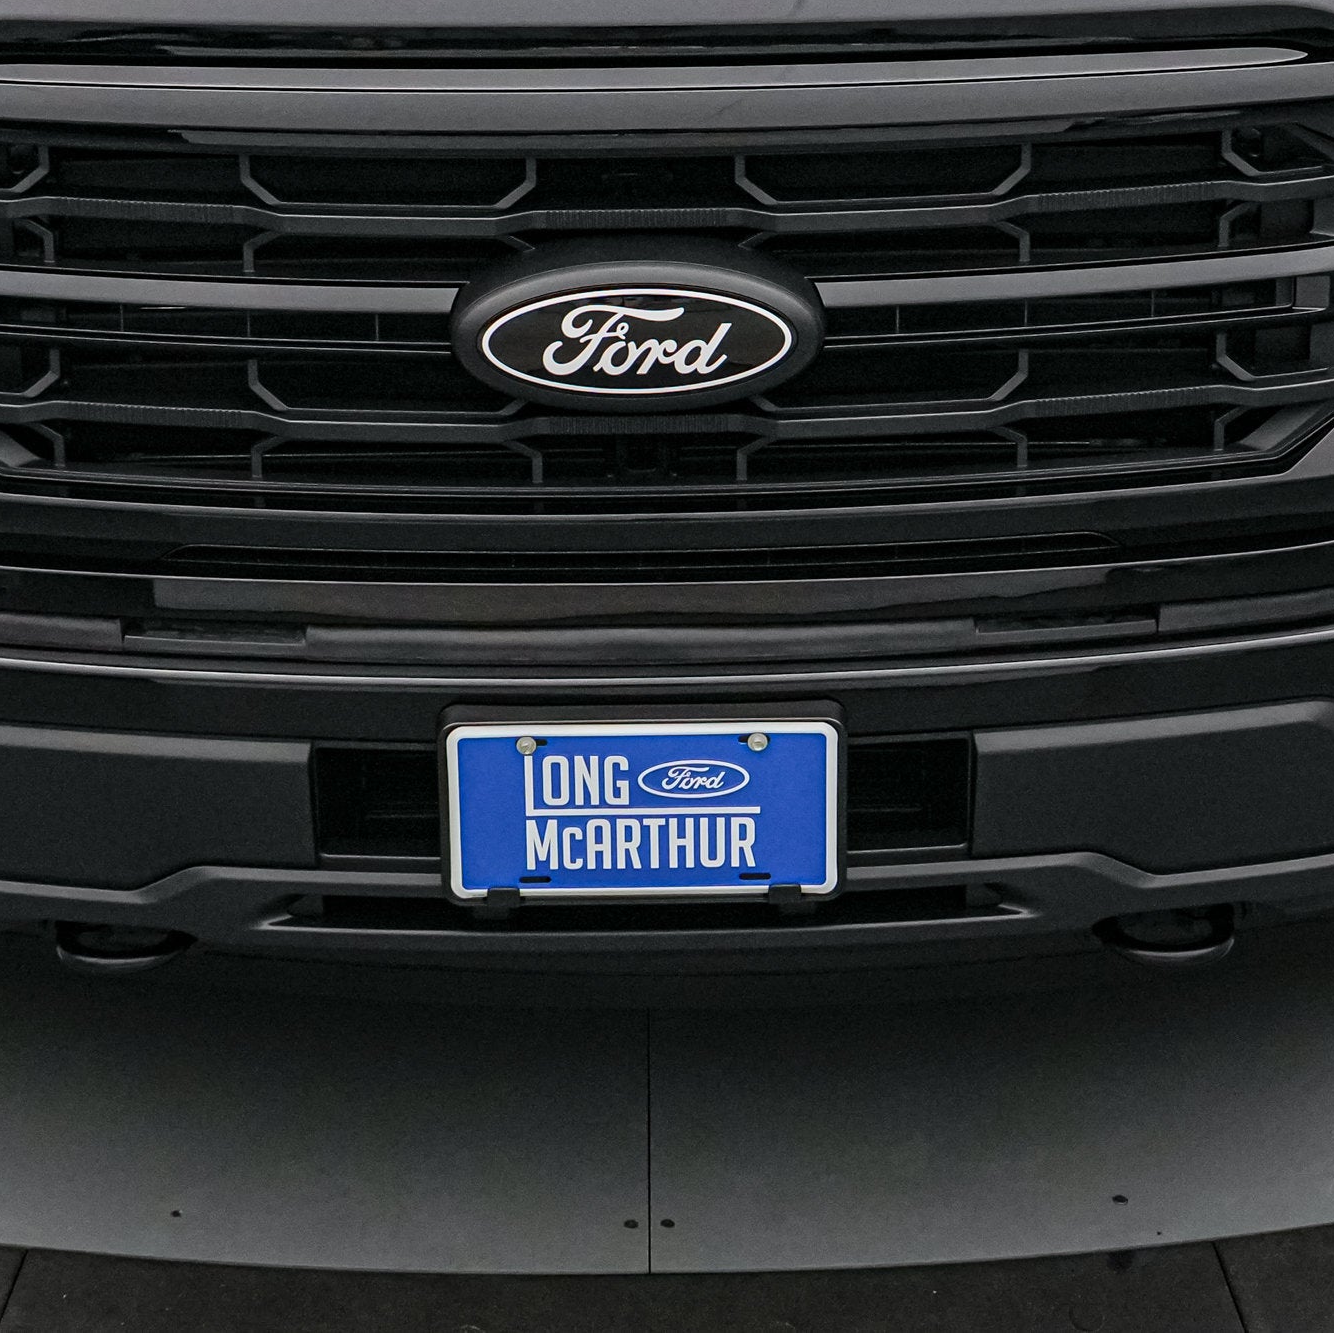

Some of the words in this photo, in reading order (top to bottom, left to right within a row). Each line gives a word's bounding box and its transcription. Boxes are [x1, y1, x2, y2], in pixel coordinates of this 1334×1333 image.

[543, 304, 732, 376] Ford
[524, 755, 630, 816] LONG
[661, 765, 726, 790] Ford
[526, 817, 757, 870] McARTHUR
